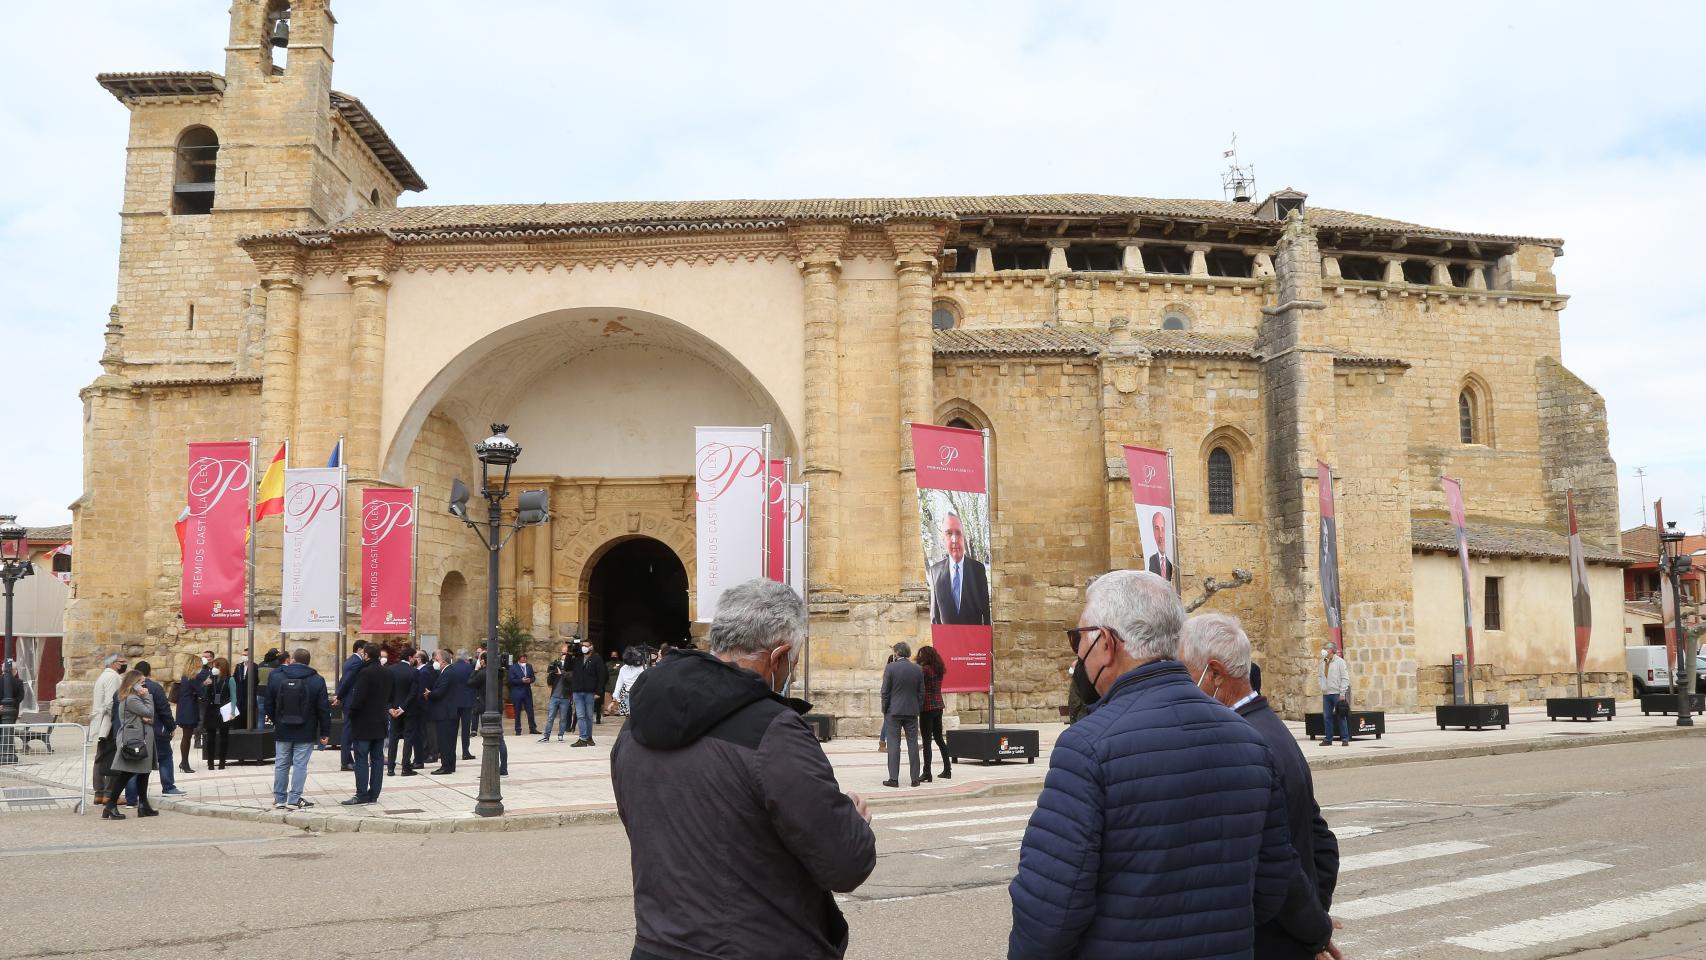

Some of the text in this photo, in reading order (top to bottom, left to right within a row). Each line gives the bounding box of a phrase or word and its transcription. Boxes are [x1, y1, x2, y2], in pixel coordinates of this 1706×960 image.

[192, 548, 205, 596] PREMIOS
[708, 537, 718, 587] PREMIOS
[370, 571, 379, 608] PREMIOS
